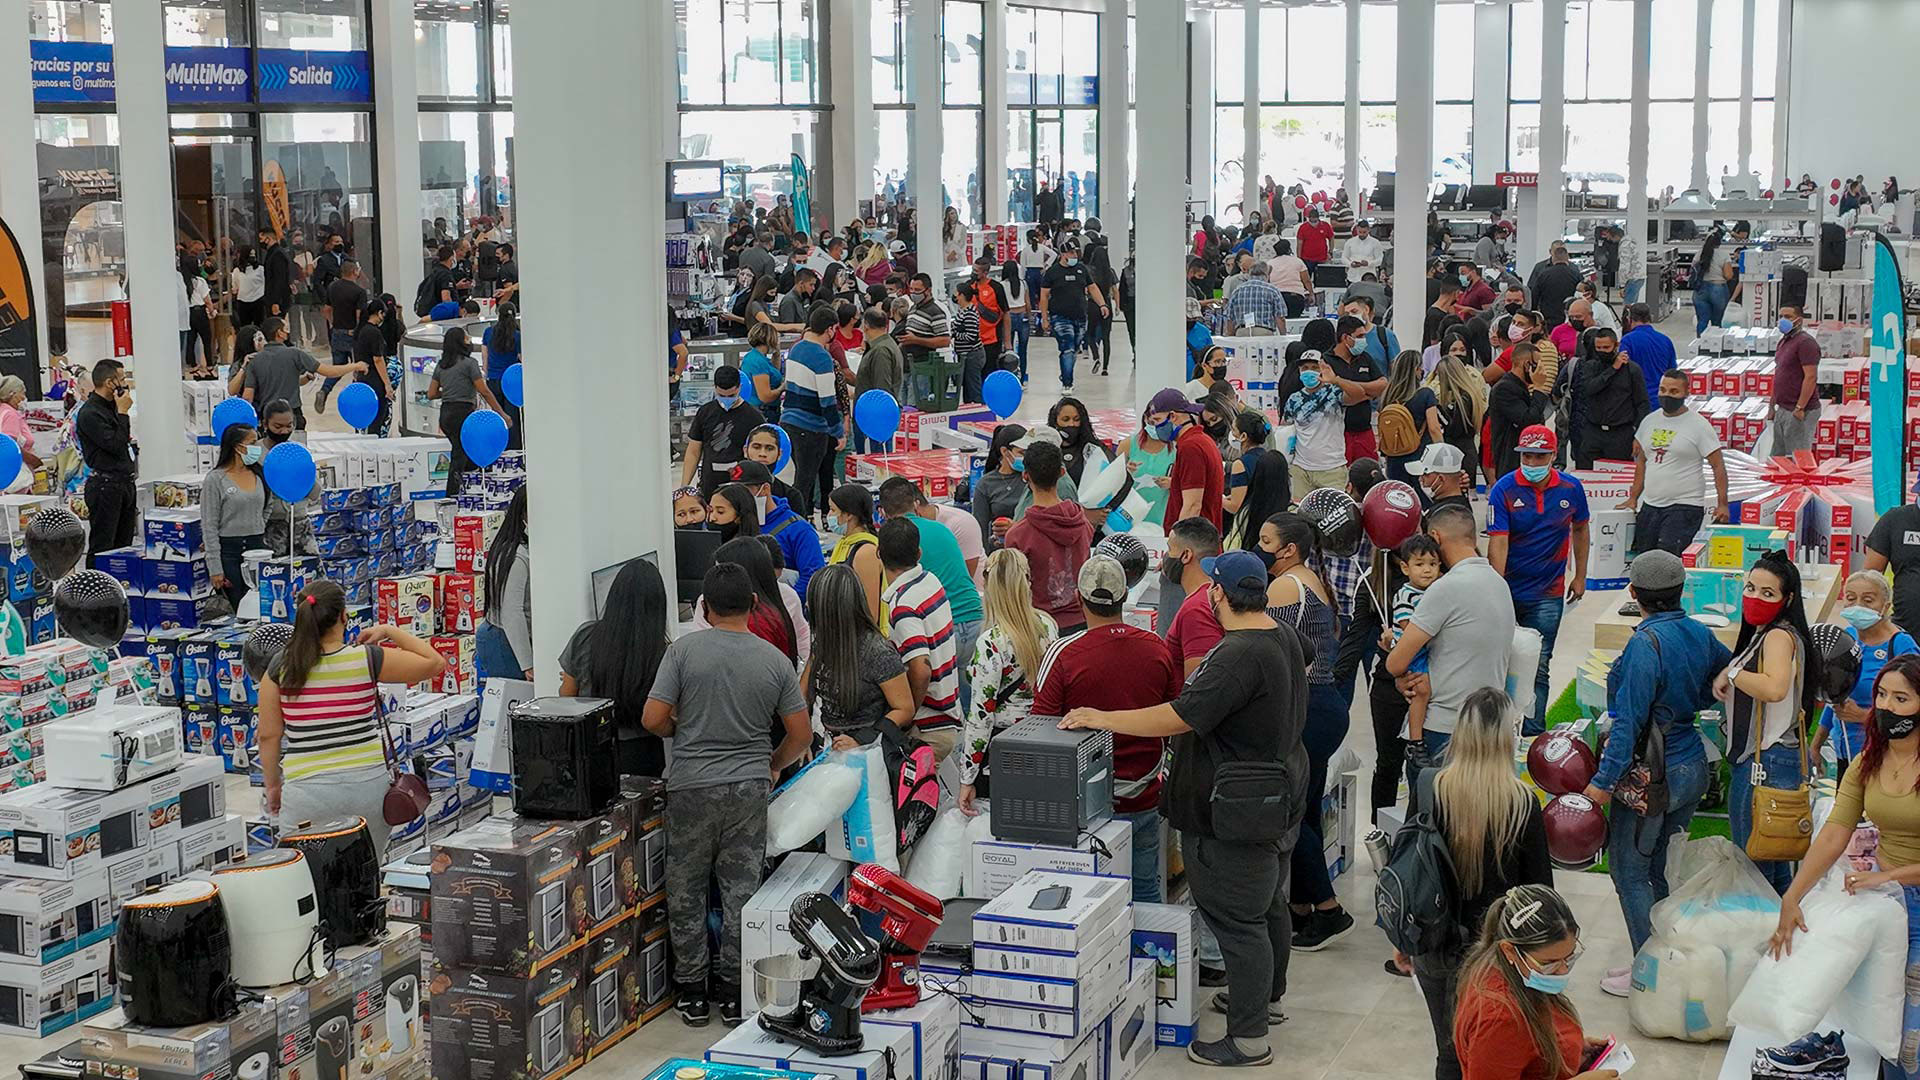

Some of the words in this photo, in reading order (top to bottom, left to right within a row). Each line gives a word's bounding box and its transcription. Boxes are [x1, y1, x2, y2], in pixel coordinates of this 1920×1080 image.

[73, 60, 94, 74] por
[96, 62, 110, 73] su
[170, 62, 241, 85] MultiMax
[289, 66, 333, 85] Salida
[1502, 175, 1536, 184] aiw
[1753, 282, 1764, 327] aiwa
[920, 415, 947, 425] aiwa
[148, 522, 163, 530] Oster
[263, 565, 284, 577] Oster
[405, 581, 427, 594] Oster
[147, 644, 167, 655] Oster
[185, 644, 208, 655] Oster
[218, 650, 239, 660] Oster
[188, 712, 208, 723] Oster
[221, 715, 241, 726] Oster
[984, 855, 1015, 864] ROYAL
